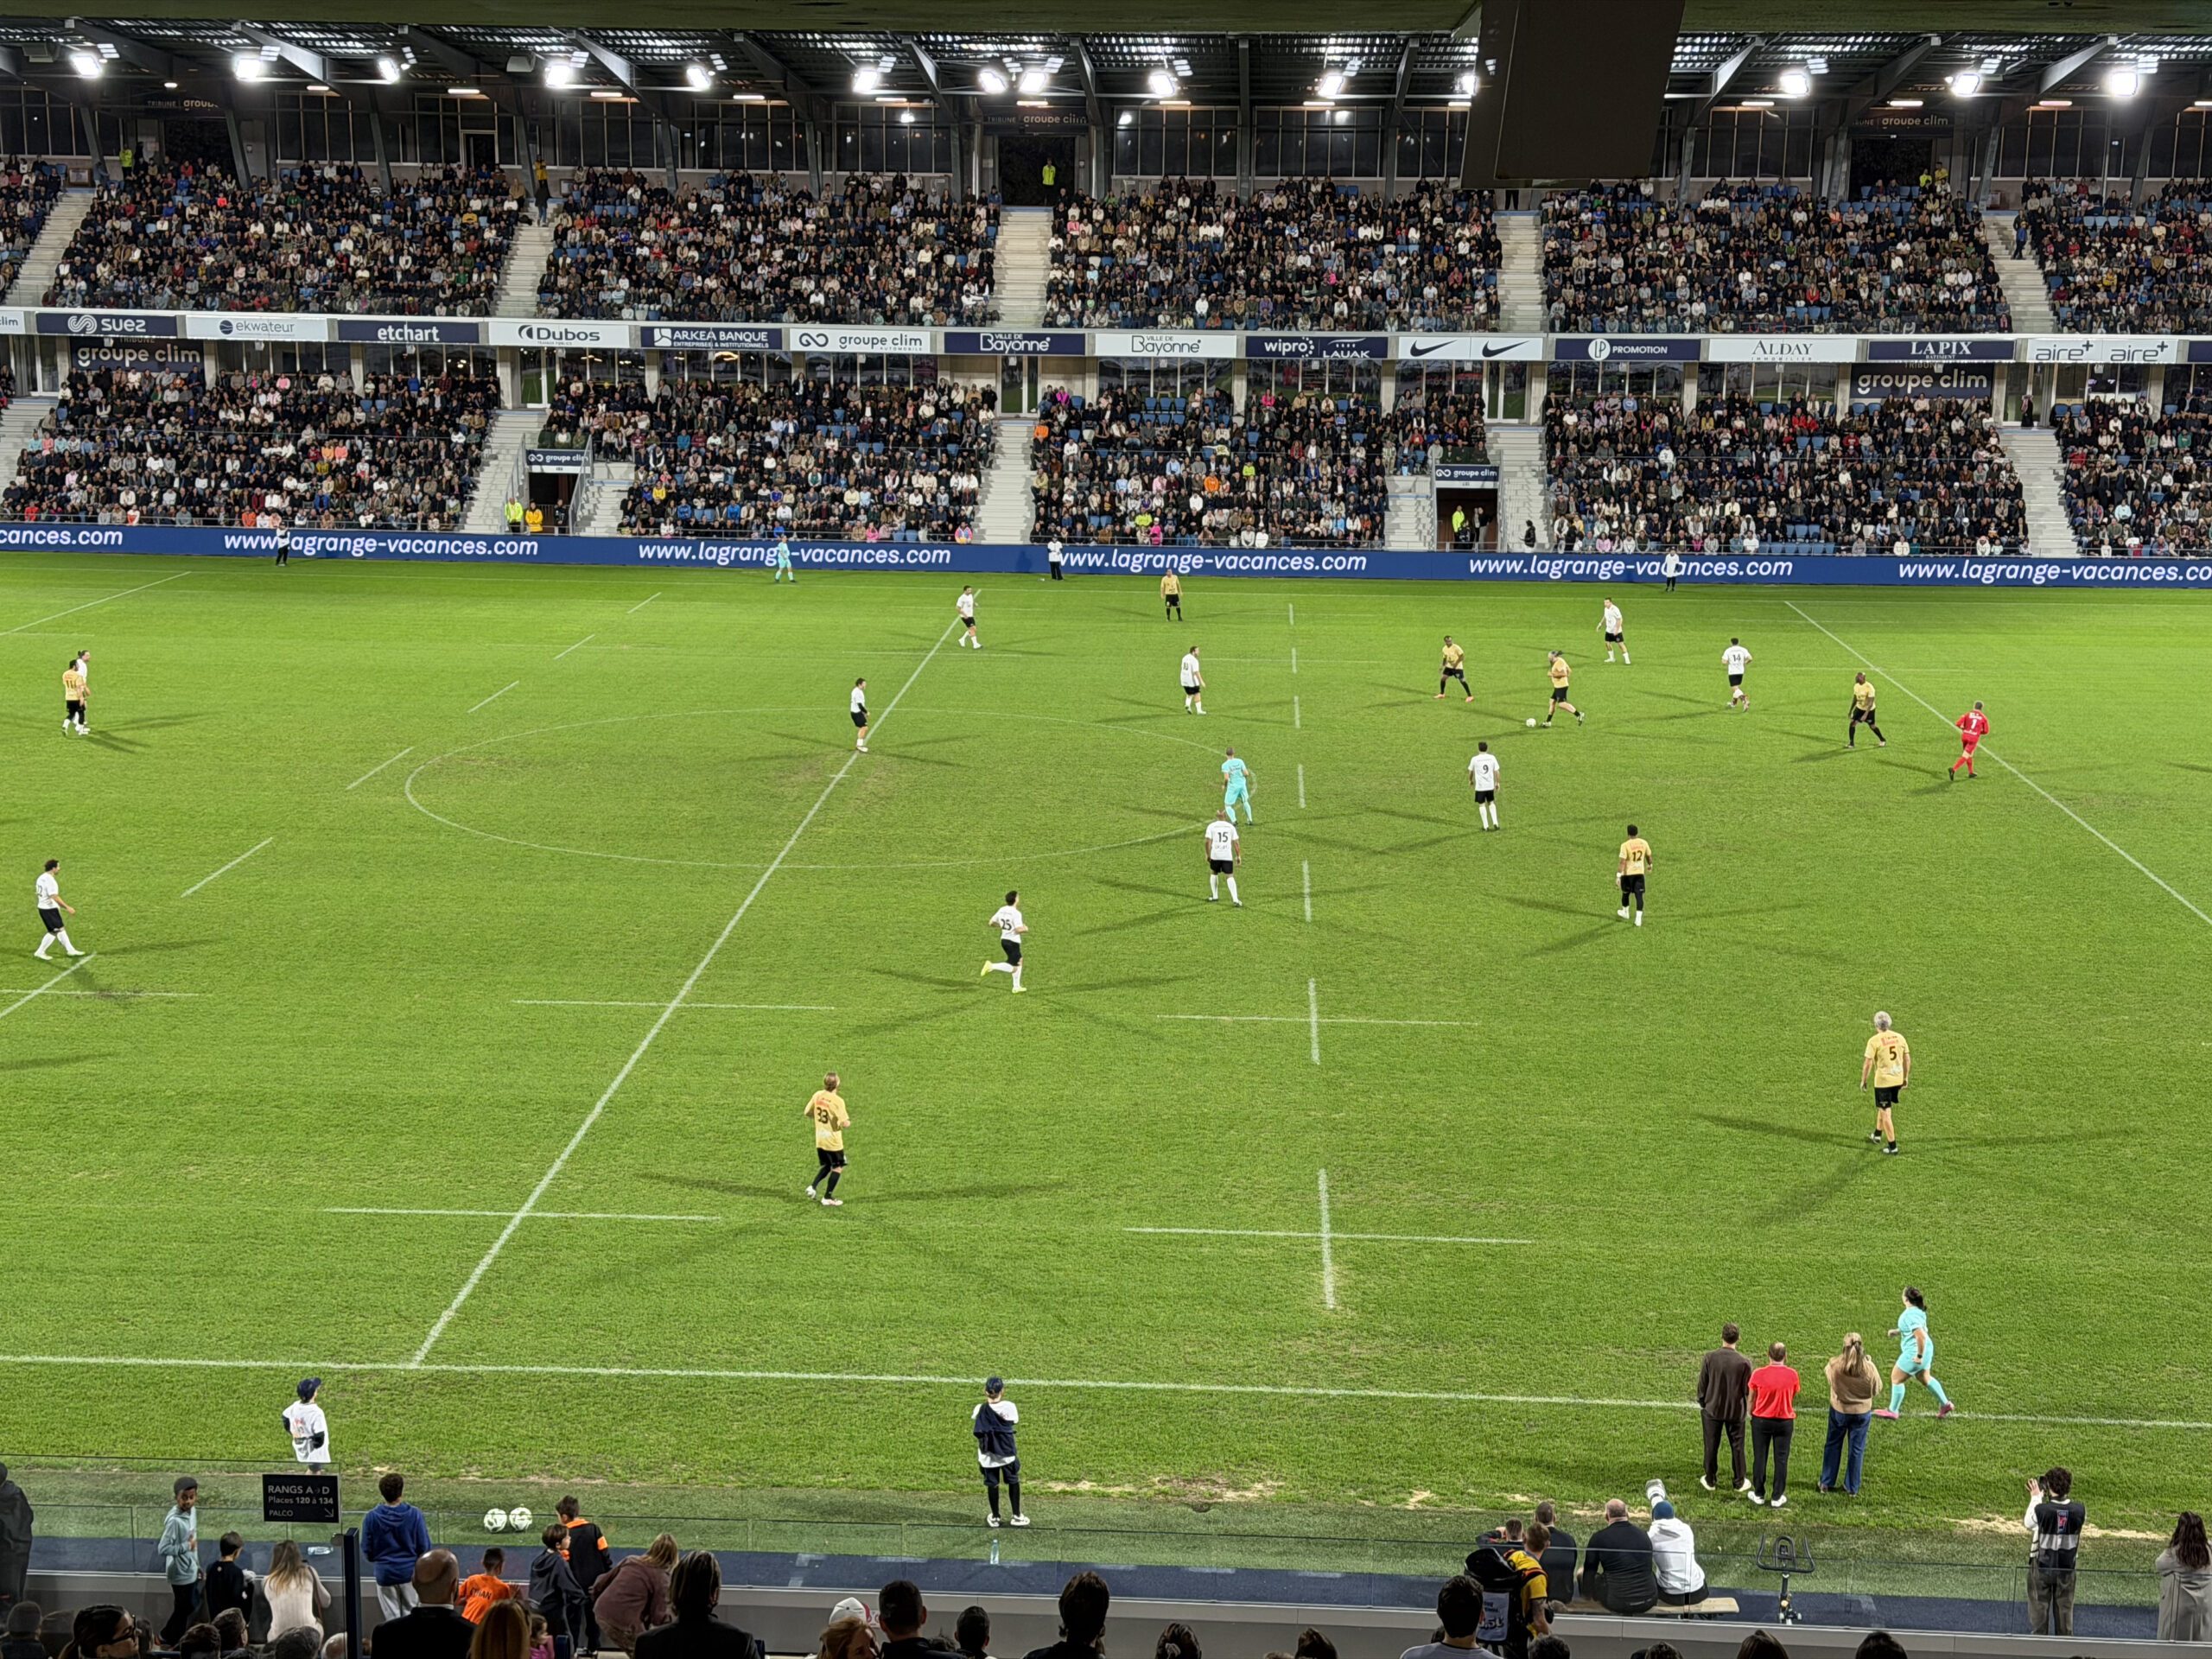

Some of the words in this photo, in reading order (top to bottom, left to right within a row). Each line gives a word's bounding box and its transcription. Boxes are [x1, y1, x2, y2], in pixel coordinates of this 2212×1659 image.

[1023, 116, 1061, 127] groupe
[1881, 118, 1922, 129] groupe
[1923, 114, 1948, 125] clim
[0, 315, 18, 326] lim
[101, 318, 146, 333] suez
[236, 320, 295, 333] ekwateur
[378, 324, 440, 342] etchart
[537, 327, 601, 341] Dubos
[719, 331, 768, 342] BANQUE
[839, 335, 887, 349] groupe
[892, 334, 923, 346] clim
[980, 333, 1051, 352] Bayonne
[1131, 334, 1201, 355] Bayonne
[1264, 338, 1307, 356] wipro
[1751, 340, 1813, 355] ALDAY
[1910, 341, 1972, 355] LAPIX
[77, 347, 149, 367] groupe
[155, 343, 200, 363] clim
[1323, 350, 1370, 359] LAUAK
[1612, 346, 1668, 354] PROMOTION
[1857, 374, 1934, 395] groupe
[1940, 368, 1987, 388] clim
[545, 454, 570, 463] groupe
[1453, 469, 1479, 478] groupe
[639, 541, 951, 566] www.lagrang-vacances.com
[1732, 653, 1741, 662] 14
[1971, 718, 1978, 729] 1
[1483, 764, 1489, 774] 9
[1217, 831, 1229, 842] 15
[1632, 849, 1643, 861] 12
[1001, 918, 1012, 931] 25
[1889, 1046, 1897, 1061] 5
[817, 1106, 829, 1124] 33
[268, 1485, 303, 1494] RANGS
[321, 1486, 330, 1495] D
[268, 1496, 294, 1504] Places
